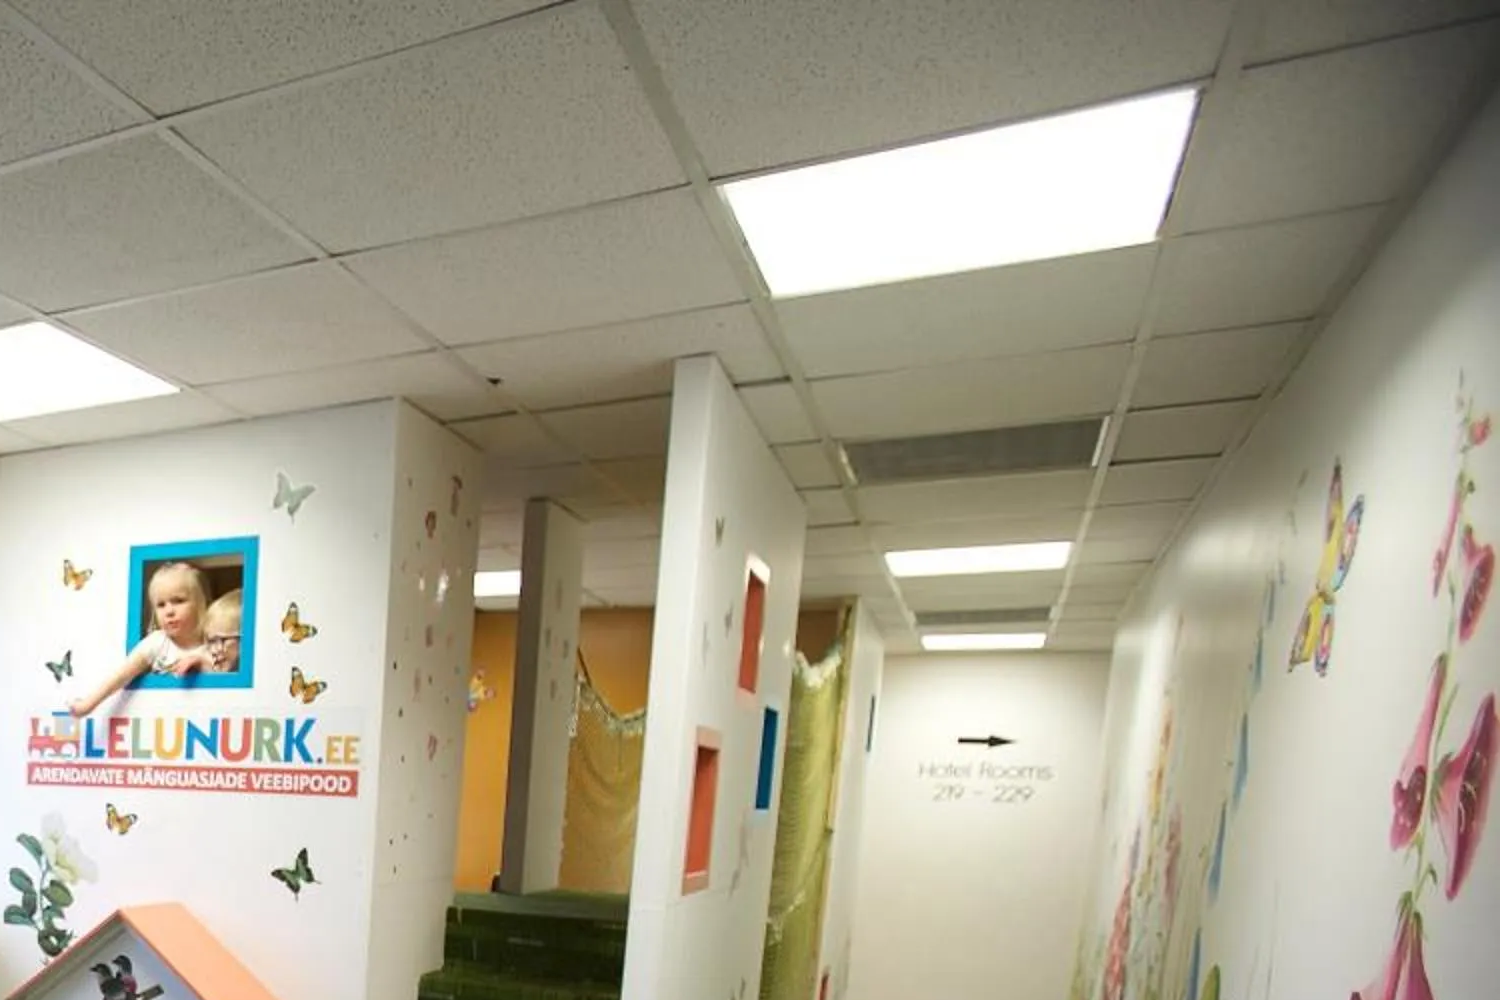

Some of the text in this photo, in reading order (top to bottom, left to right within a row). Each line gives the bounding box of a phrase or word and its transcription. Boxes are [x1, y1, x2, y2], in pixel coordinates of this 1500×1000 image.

[32, 767, 125, 784] ARENDAVATE
[251, 773, 352, 793] VEEBIPOOD
[918, 762, 1052, 780] Hotel Rooms
[932, 783, 965, 801] 219
[991, 783, 1034, 803] 229
